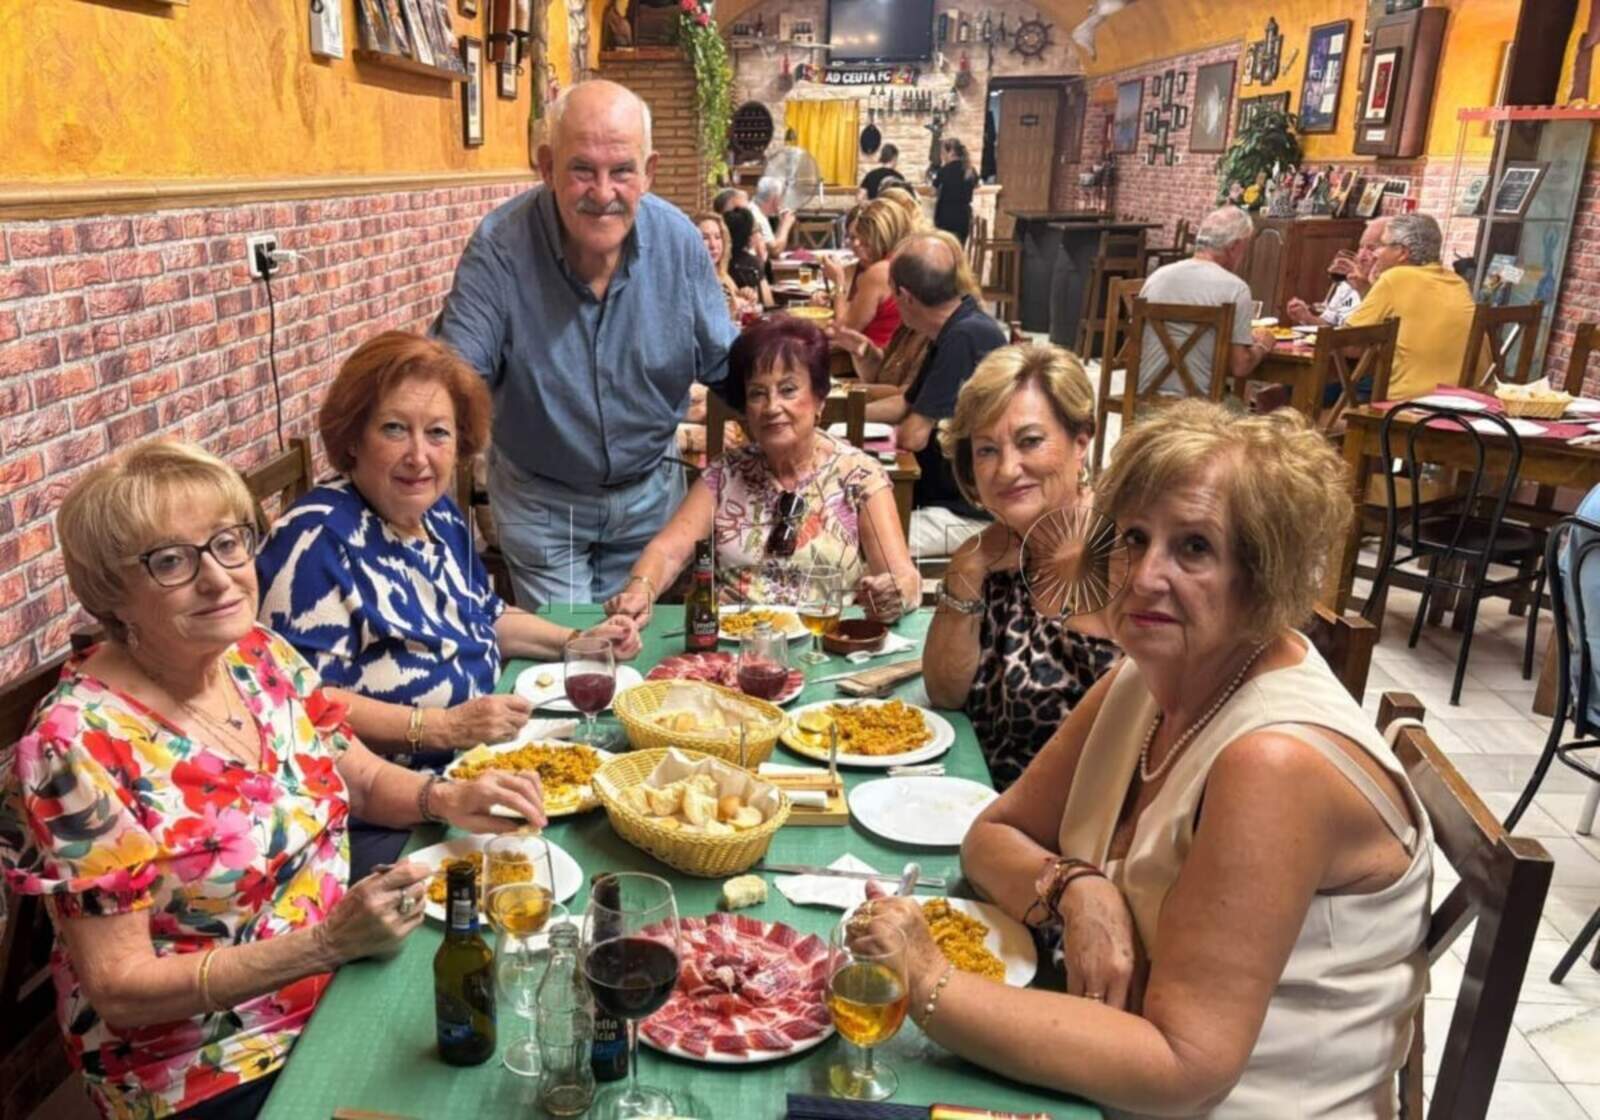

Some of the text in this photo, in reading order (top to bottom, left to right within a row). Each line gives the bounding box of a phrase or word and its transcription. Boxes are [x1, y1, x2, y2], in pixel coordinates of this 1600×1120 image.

[825, 70, 892, 84] AD CEUTA FC
